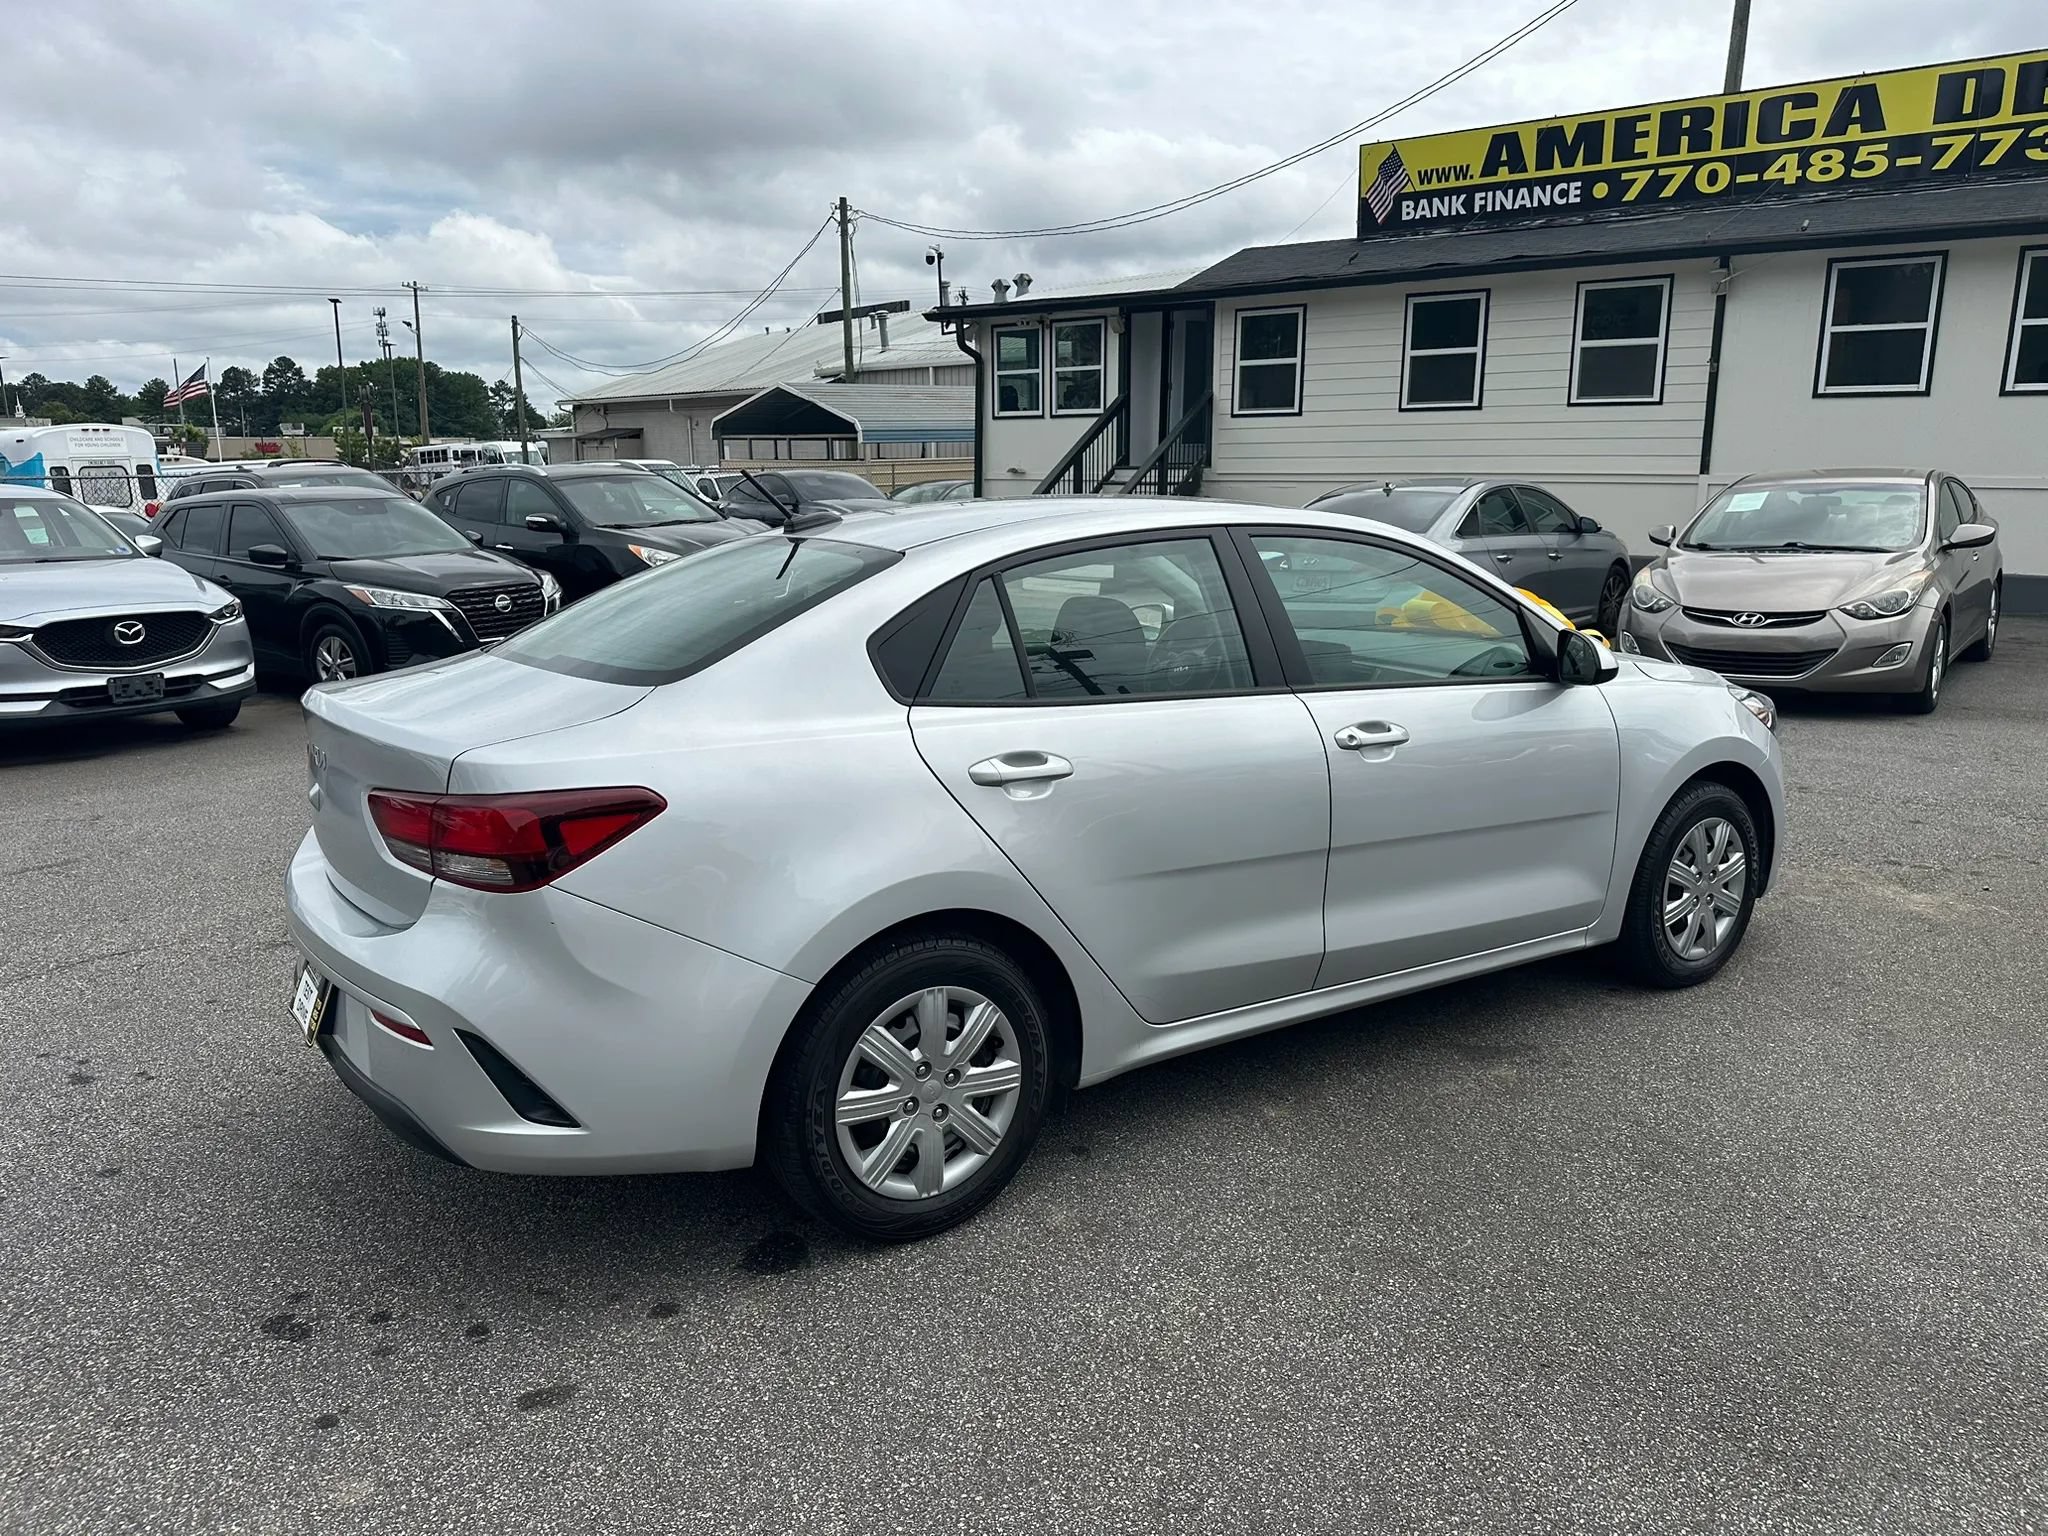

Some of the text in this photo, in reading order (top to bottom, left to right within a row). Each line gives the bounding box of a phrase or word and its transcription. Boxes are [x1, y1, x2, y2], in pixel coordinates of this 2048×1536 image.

[1479, 83, 1887, 178] AMERICA
[1401, 194, 1467, 221] BANK
[1474, 181, 1582, 213] FINANCE
